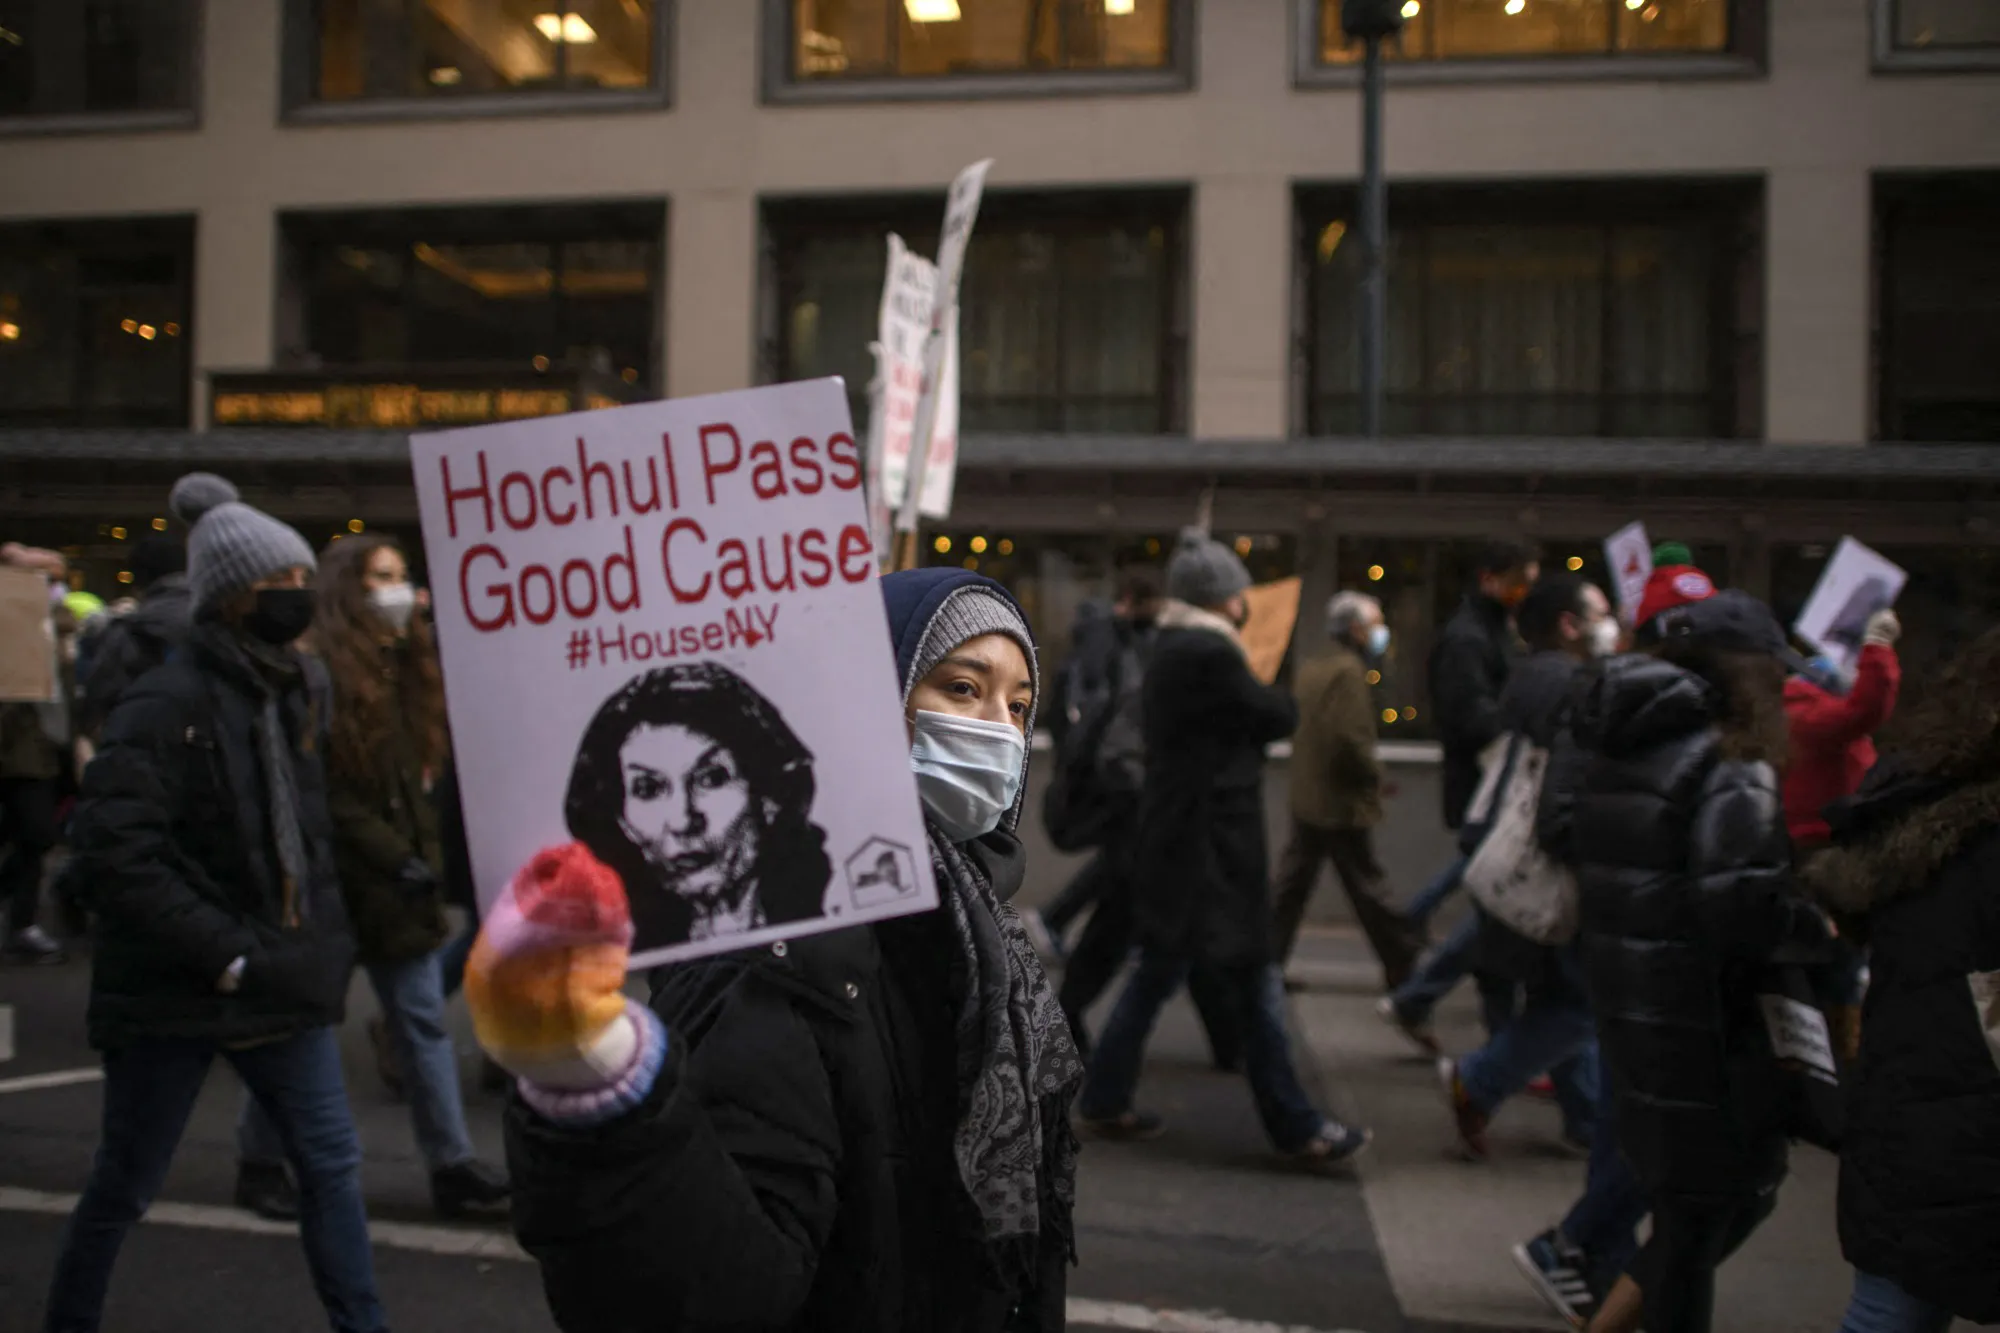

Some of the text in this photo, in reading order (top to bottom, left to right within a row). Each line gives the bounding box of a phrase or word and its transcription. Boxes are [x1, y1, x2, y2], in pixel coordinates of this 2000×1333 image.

[440, 423, 862, 538] Hochul Pass
[459, 517, 873, 632] Good Cause
[566, 603, 779, 669] #HouseNY
